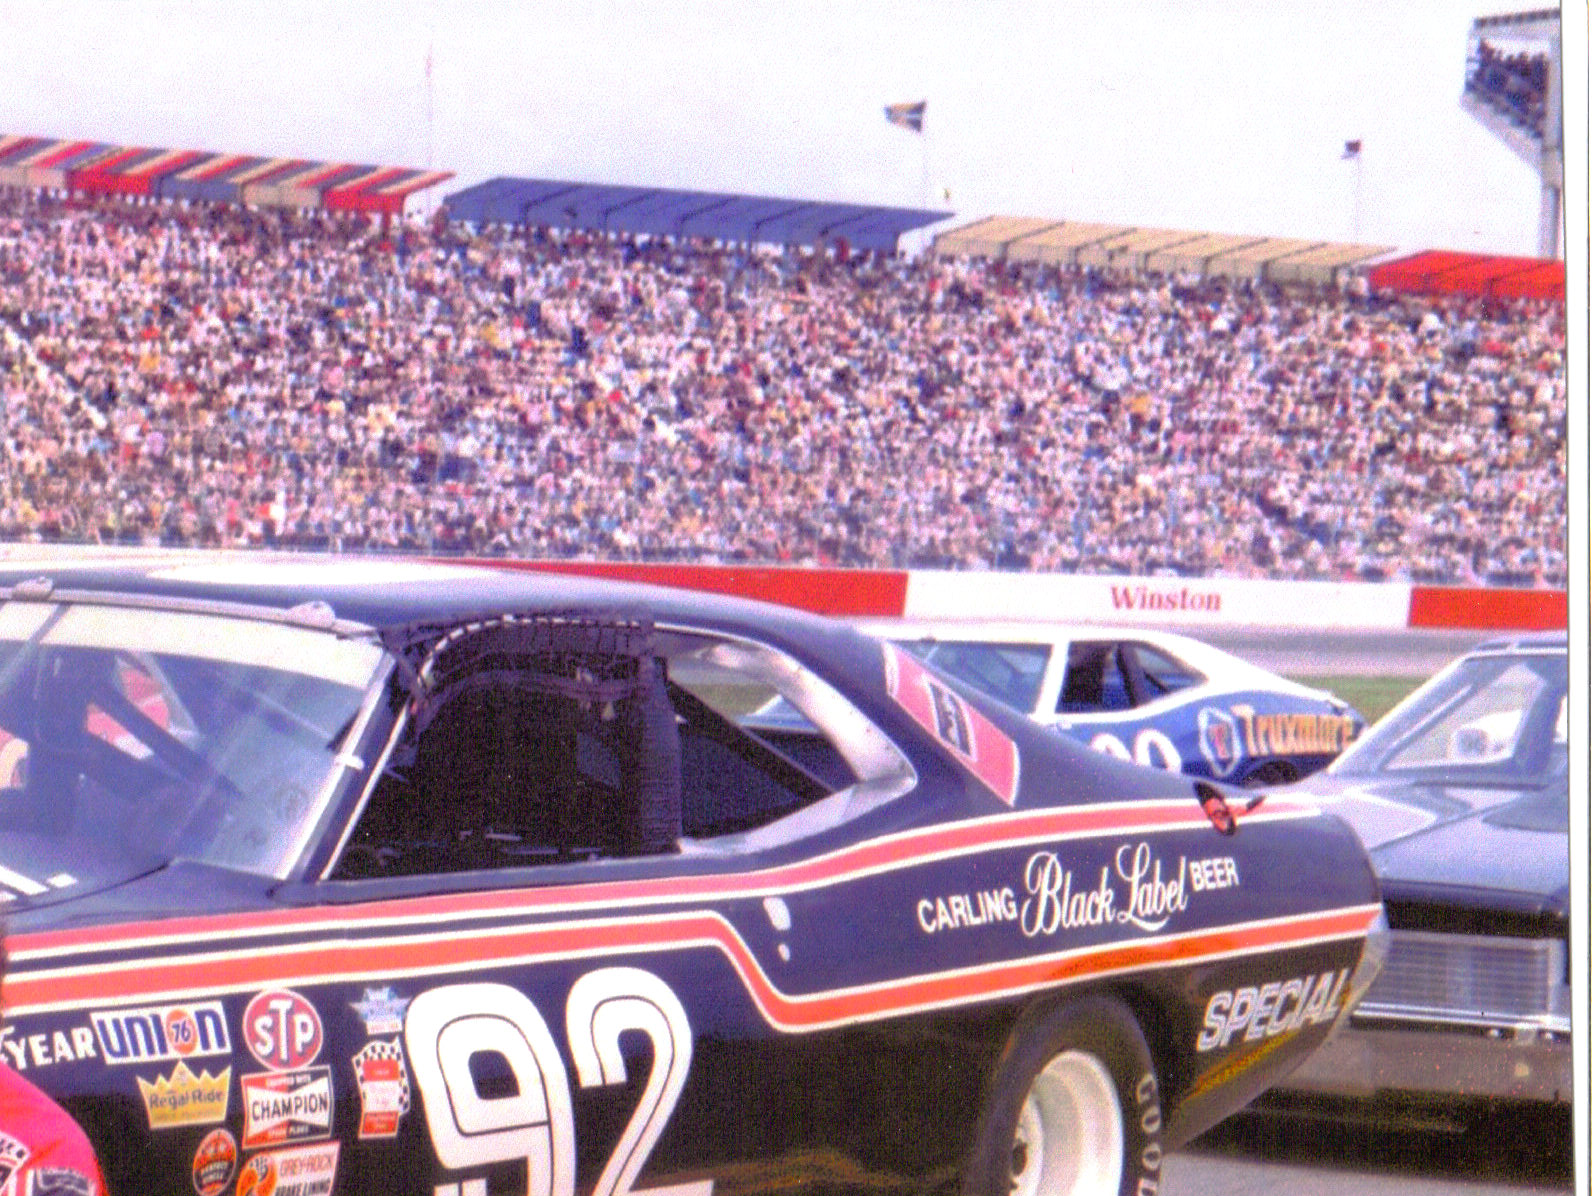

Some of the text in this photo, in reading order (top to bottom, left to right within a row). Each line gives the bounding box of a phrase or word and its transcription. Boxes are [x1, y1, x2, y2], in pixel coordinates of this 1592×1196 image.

[1110, 584, 1221, 613] Winston
[916, 841, 1240, 938] CARLING Black Label BEER
[1196, 967, 1351, 1053] SPECIAL
[170, 1020, 192, 1044] 76
[254, 999, 315, 1063] STP
[191, 1088, 224, 1104] Ride
[251, 1092, 329, 1121] CHAMPION
